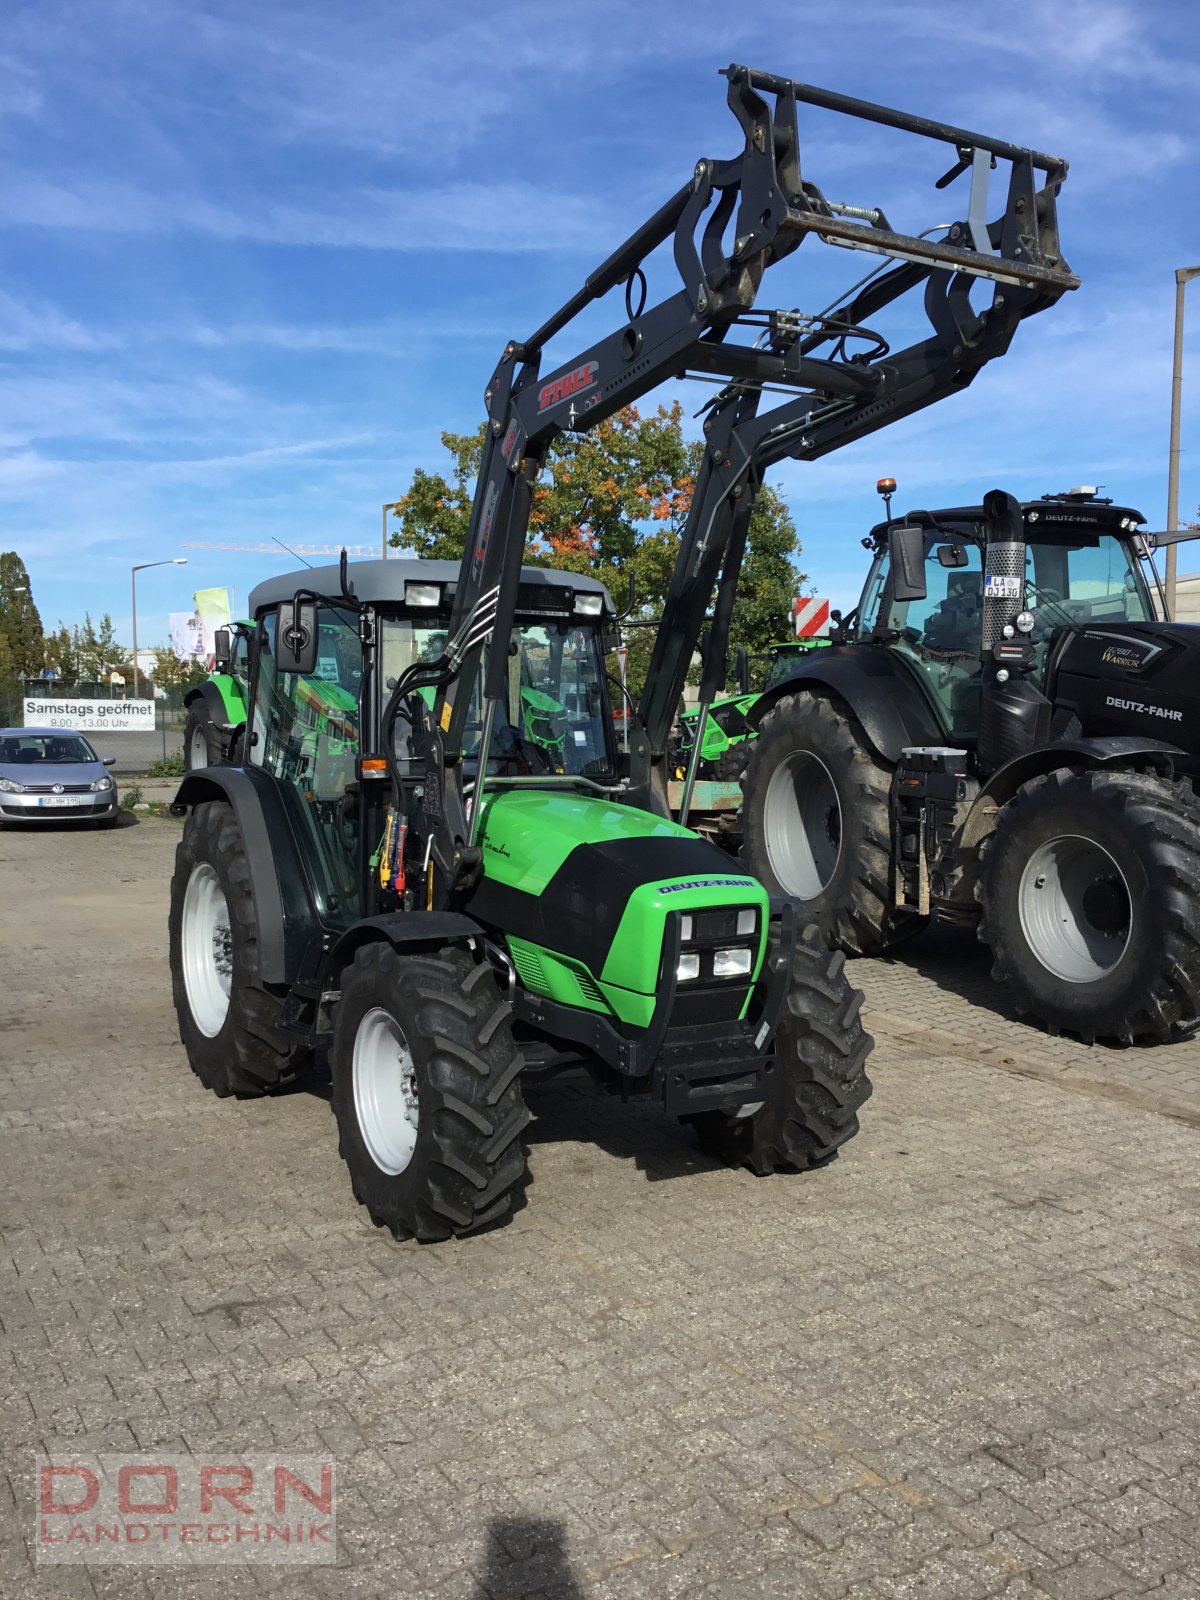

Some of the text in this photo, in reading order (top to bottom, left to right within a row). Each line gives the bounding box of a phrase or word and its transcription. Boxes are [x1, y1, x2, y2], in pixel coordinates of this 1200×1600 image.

[539, 364, 593, 409] STOLL
[1045, 514, 1098, 523] DEUTZ-FAHR
[994, 577, 1005, 587] LA
[987, 587, 1018, 597] DJ 130
[26, 702, 152, 717] Samstags geöffnet
[1105, 696, 1183, 721] DEUTZ-FAHR
[50, 718, 72, 727] 9.00
[82, 718, 109, 727] 13.00
[111, 718, 129, 727] Uhr
[658, 879, 756, 895] DEUTZ-FAHR
